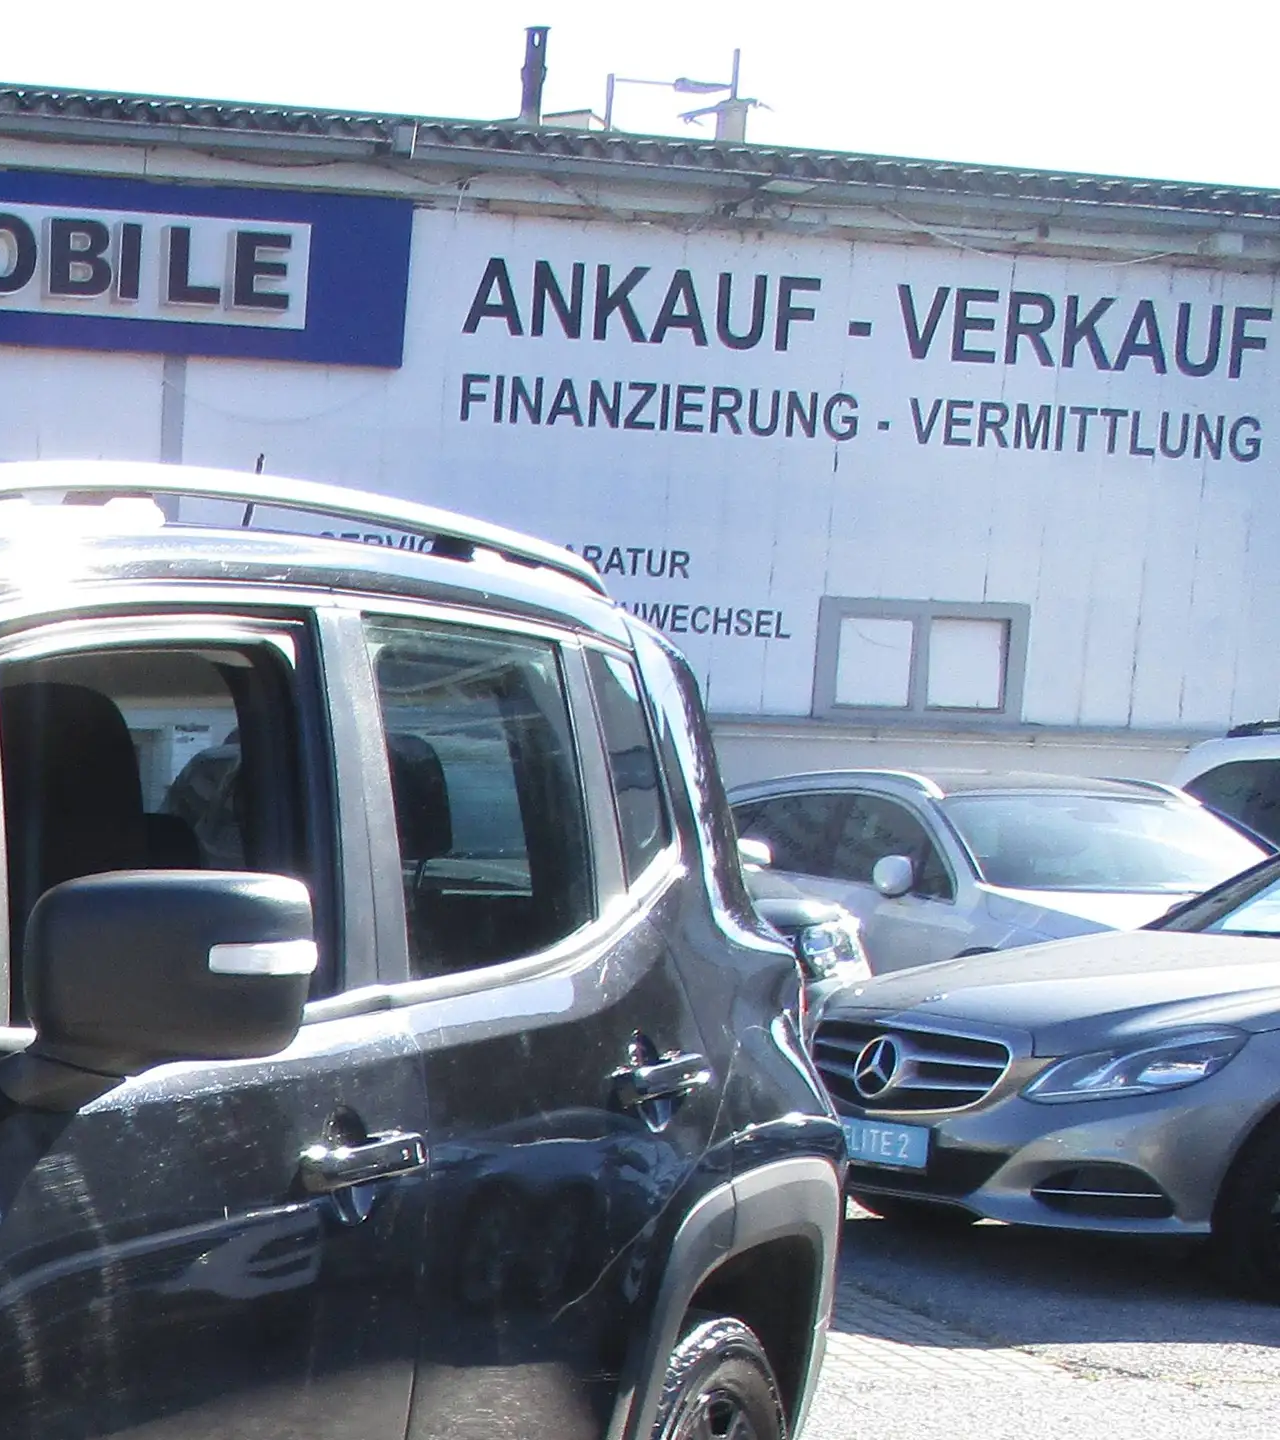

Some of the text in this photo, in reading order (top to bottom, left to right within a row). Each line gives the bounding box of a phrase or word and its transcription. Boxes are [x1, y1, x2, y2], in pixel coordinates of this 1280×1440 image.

[462, 258, 823, 352] ANKAUF
[897, 283, 1273, 380] VERKAUF
[458, 373, 860, 442] FINANZIERUNG
[908, 397, 1263, 464] VERMITTLUNG
[896, 1132, 909, 1158] 2
